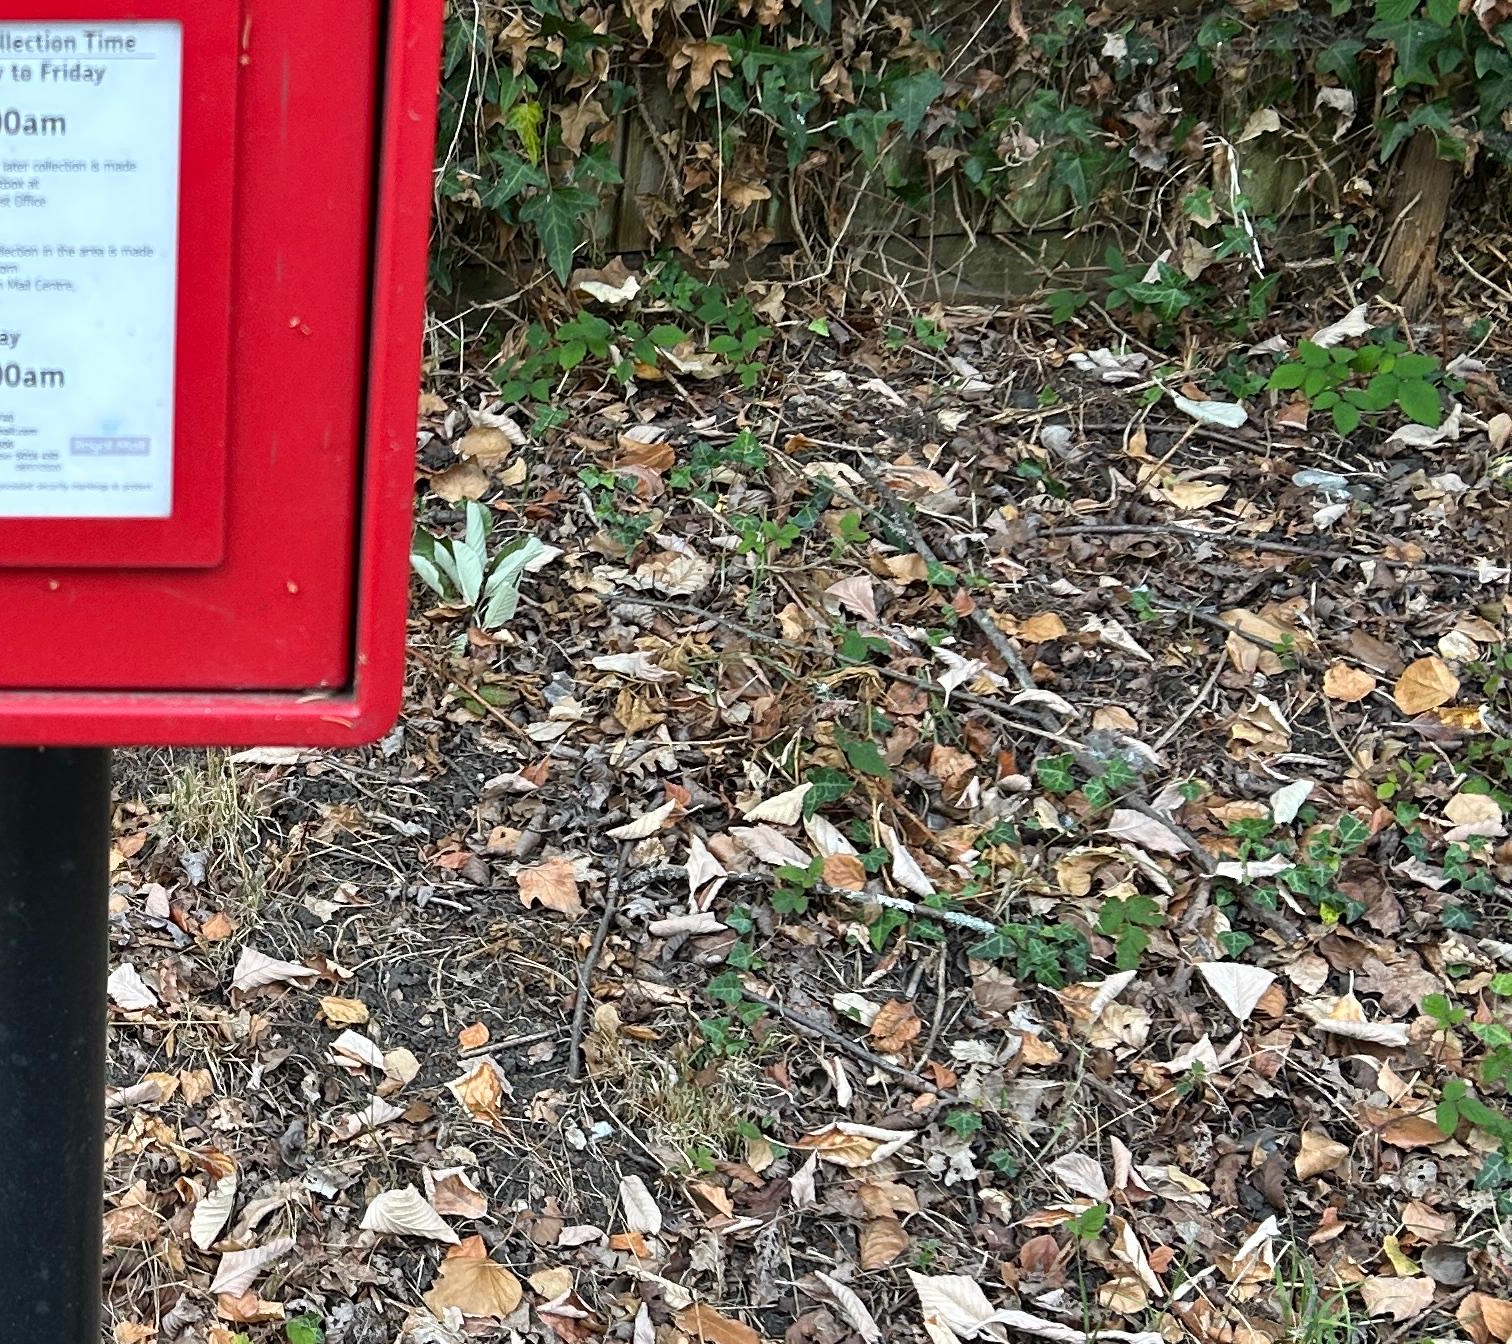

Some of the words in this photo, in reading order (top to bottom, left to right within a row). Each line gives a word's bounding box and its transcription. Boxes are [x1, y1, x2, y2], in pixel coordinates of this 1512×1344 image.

[85, 29, 136, 53] Time
[11, 63, 32, 81] to
[40, 62, 106, 85] Friday
[3, 160, 28, 172] later
[33, 160, 87, 172] collection
[91, 160, 100, 172] is
[104, 160, 137, 172] made
[28, 179, 39, 190] at
[15, 196, 47, 208] Office
[43, 246, 53, 257] in
[57, 246, 76, 257] the
[80, 248, 105, 257] area
[108, 246, 118, 257] is
[121, 246, 154, 258] made
[8, 279, 31, 291] Mail
